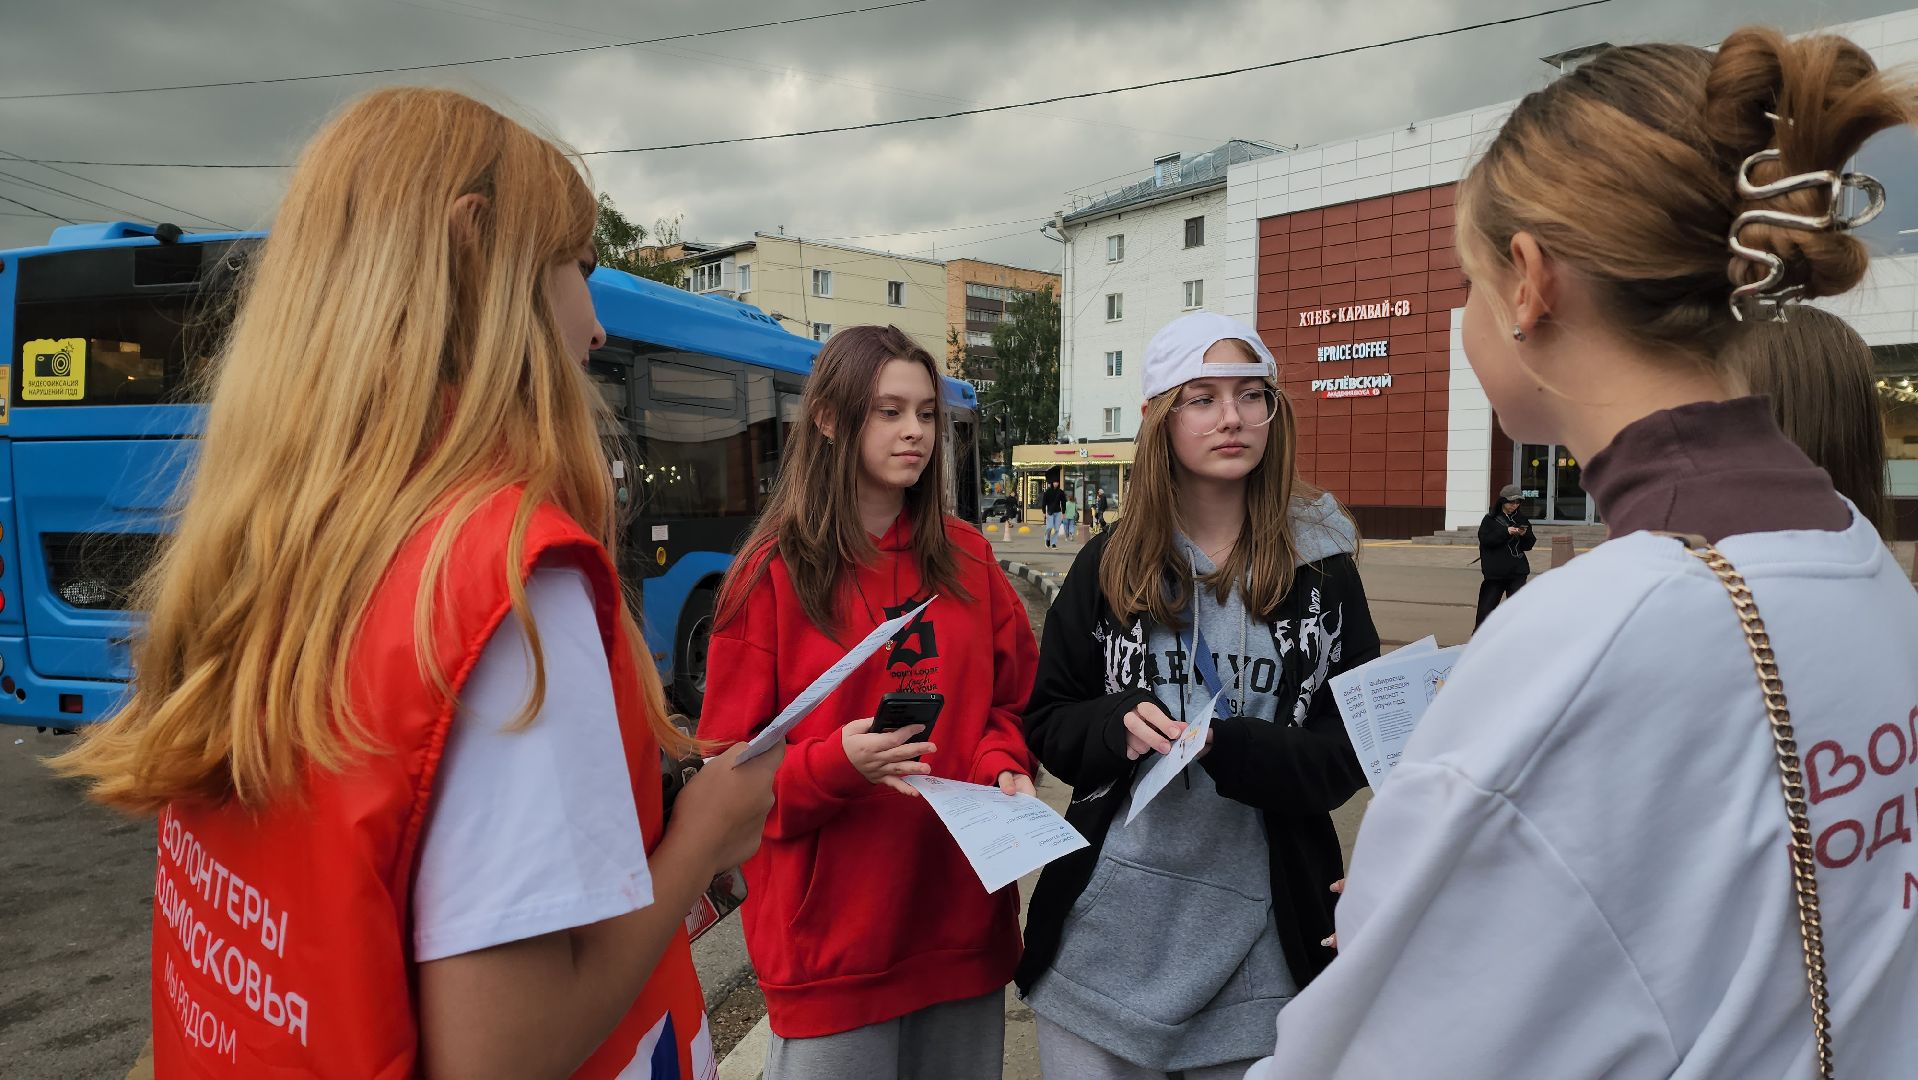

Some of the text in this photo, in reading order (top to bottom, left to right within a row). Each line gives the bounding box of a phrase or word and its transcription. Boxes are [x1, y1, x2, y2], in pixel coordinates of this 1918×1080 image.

[1299, 300, 1411, 327] ХЛЕБ КАРАВАЙ СВ
[1324, 340, 1388, 361] PRICE COFFEE
[64, 388, 78, 397] ПДД
[1311, 373, 1392, 391] РУБЛЁВСКИЙ
[1804, 705, 1918, 805] ВО
[162, 803, 289, 959] ВОЛОНТЕРЫ
[164, 951, 238, 1065] МЫ РЯДОМ
